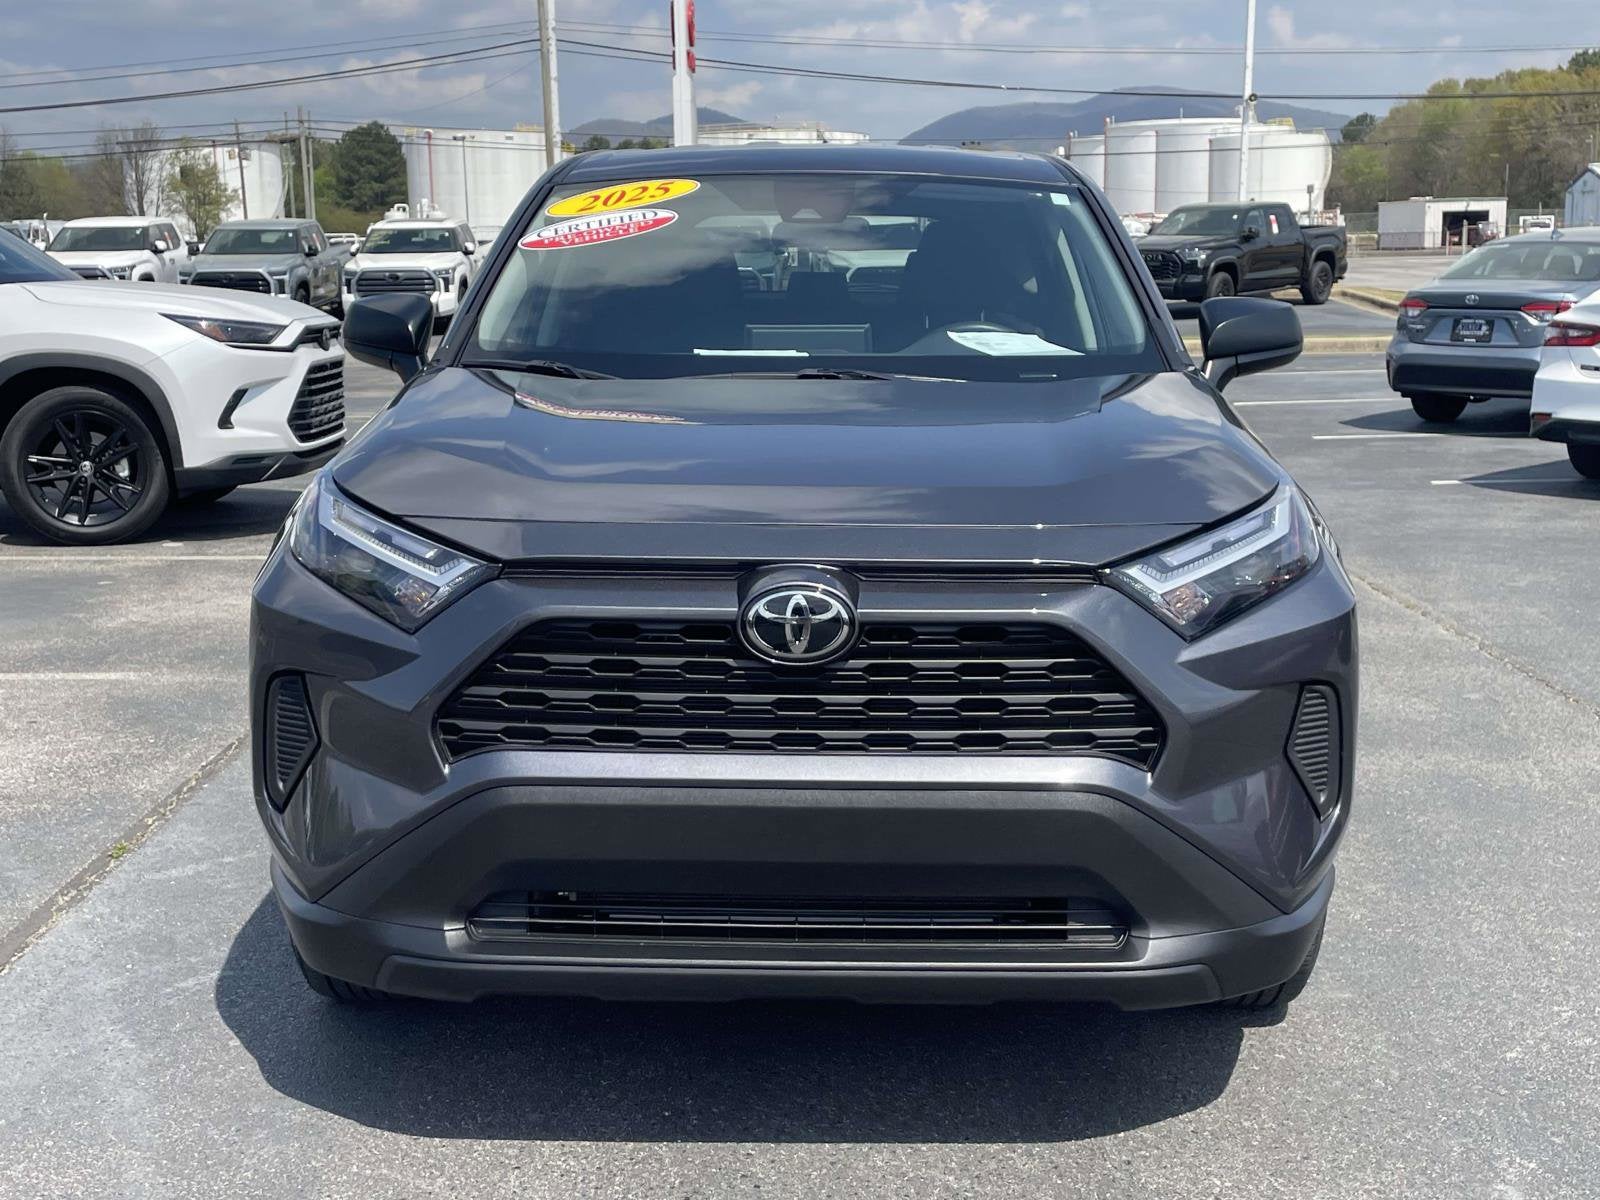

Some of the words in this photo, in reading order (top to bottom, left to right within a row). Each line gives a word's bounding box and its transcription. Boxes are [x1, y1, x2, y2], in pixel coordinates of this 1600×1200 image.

[576, 181, 675, 212] 2025
[536, 210, 659, 239] CERTIFIED
[543, 220, 655, 244] PRE-OWNED
[561, 226, 640, 245] VEHICLE
